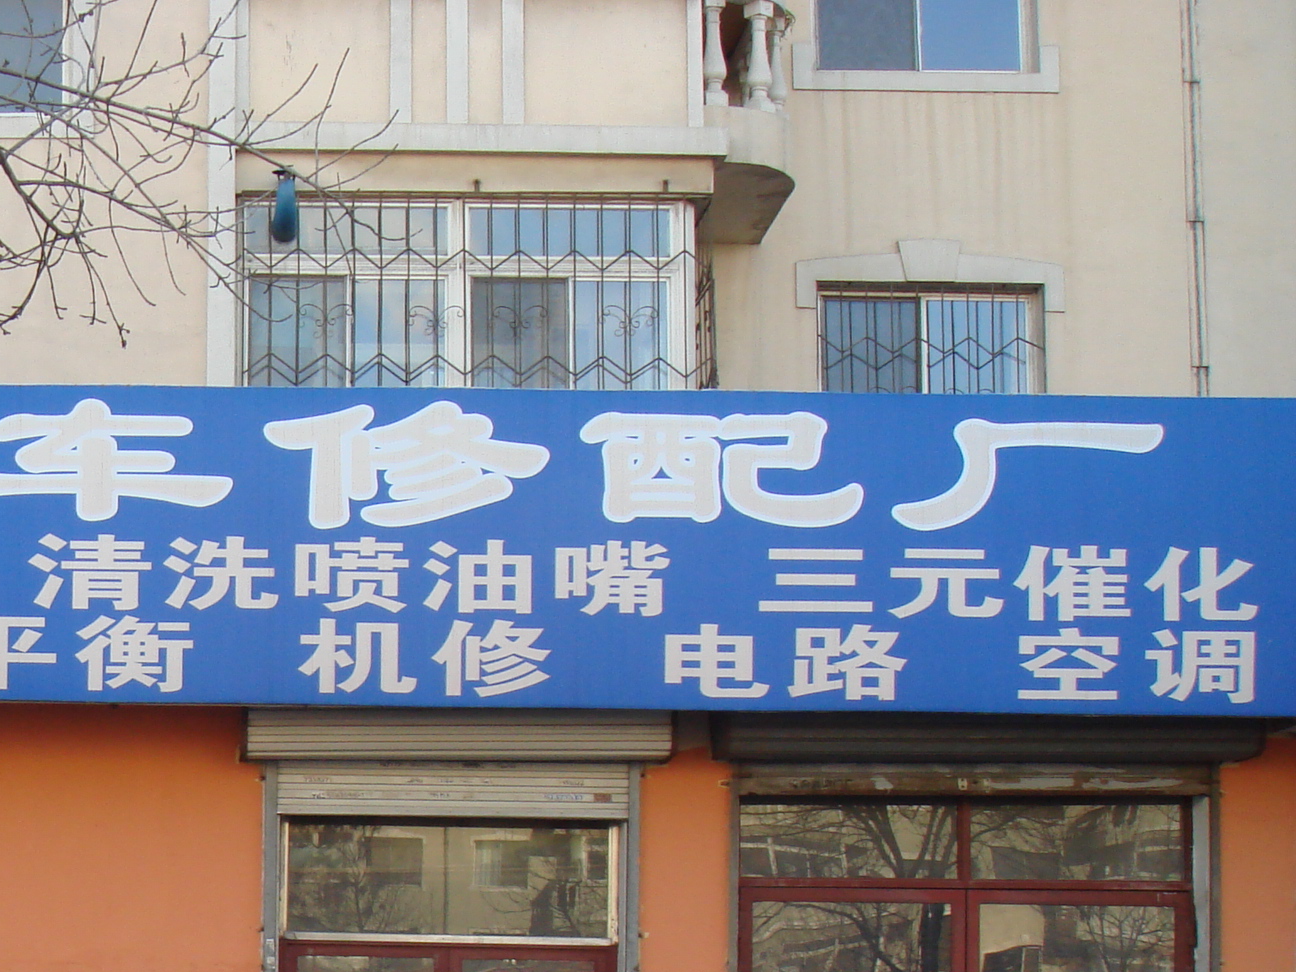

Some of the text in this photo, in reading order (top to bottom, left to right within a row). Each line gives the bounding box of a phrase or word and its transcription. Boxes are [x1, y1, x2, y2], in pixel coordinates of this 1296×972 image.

[27, 534, 671, 616] 清洗喷油嘴
[758, 545, 1258, 622] 三元催化
[298, 620, 552, 698] 机修
[664, 623, 907, 701] 电路
[1018, 627, 1256, 704] 空调
